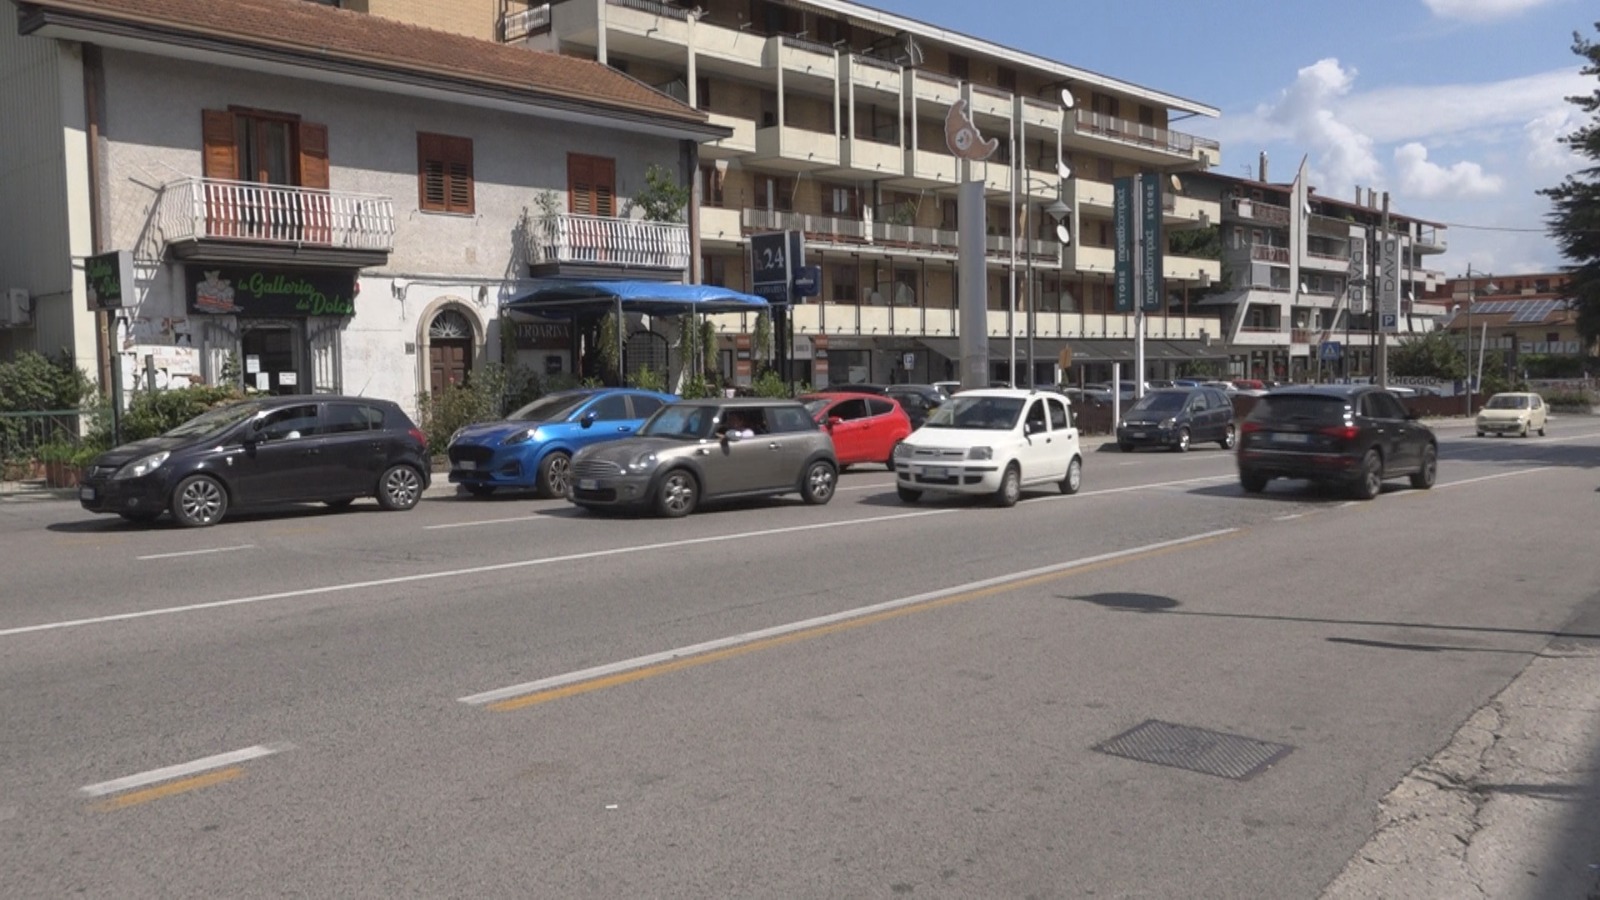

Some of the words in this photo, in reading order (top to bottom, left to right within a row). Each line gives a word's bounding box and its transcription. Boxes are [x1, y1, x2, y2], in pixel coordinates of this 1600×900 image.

[1146, 184, 1155, 220] STORE
[249, 272, 315, 299] Galleria
[1118, 270, 1126, 305] STORE
[309, 292, 353, 315] Dolci
